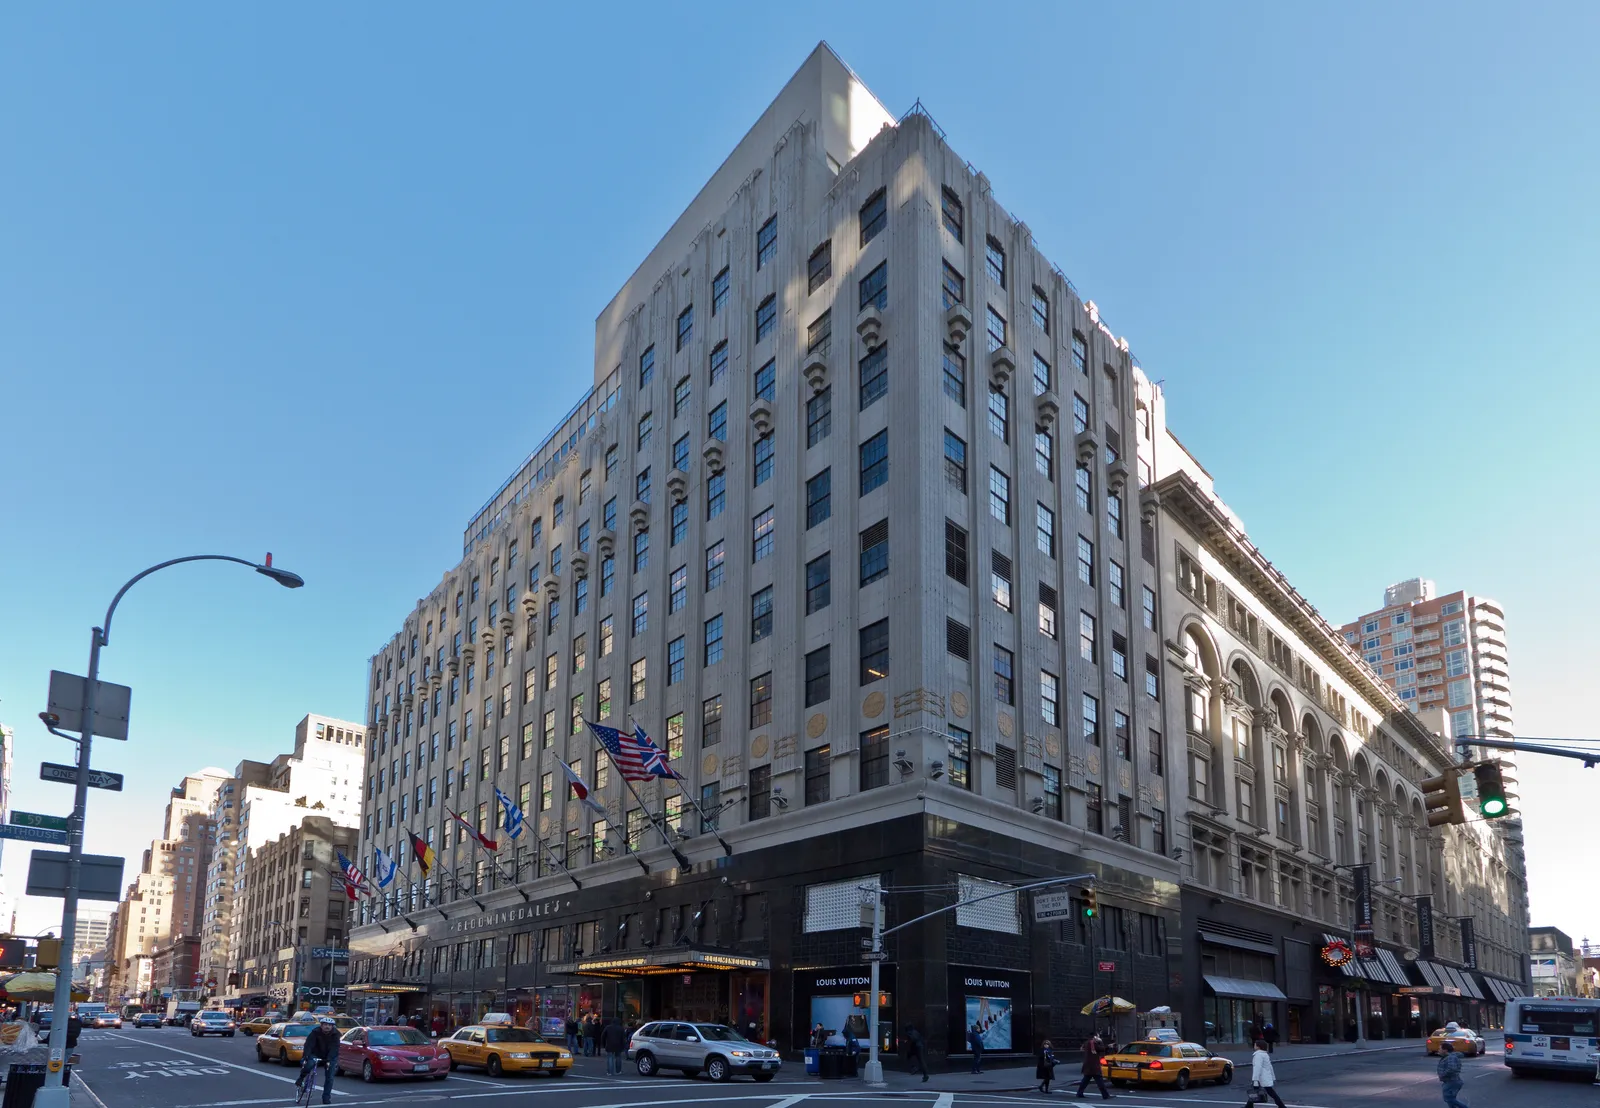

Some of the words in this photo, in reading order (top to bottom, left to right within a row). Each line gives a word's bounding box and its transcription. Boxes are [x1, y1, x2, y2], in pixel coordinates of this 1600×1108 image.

[52, 769, 74, 779] ONE
[89, 774, 111, 785] WAY
[14, 813, 20, 823] E
[27, 815, 42, 826] 59
[457, 900, 560, 932] BLOOMINGDALE'S
[816, 979, 837, 987] LOUIS
[838, 977, 870, 986] VUITTON
[965, 978, 983, 987] LOUIS
[984, 979, 1010, 988] VUITTON
[296, 986, 346, 997] COHE
[124, 1067, 231, 1080] ONLY
